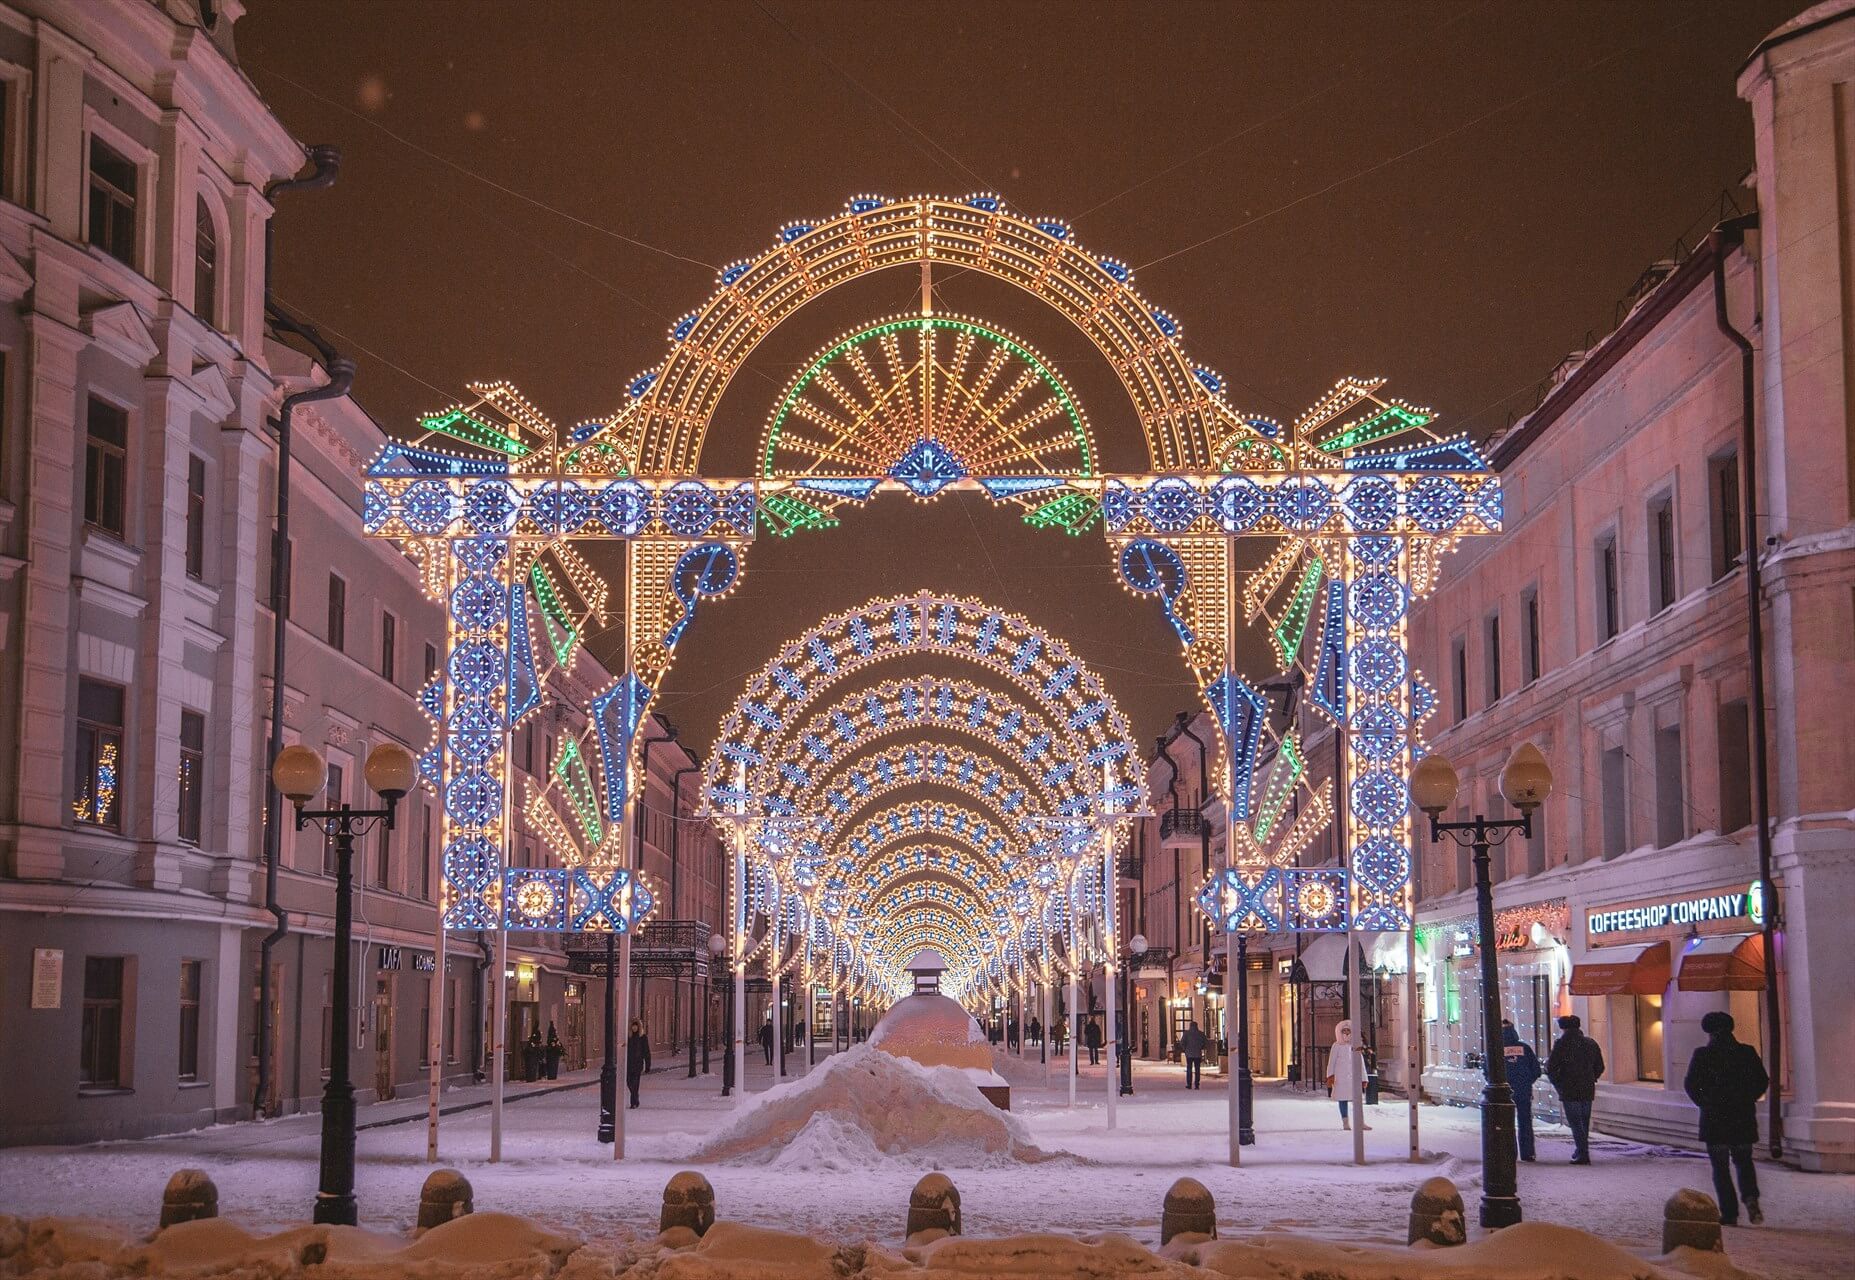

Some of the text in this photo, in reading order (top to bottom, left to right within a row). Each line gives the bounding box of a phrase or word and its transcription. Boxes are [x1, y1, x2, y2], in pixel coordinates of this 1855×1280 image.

[1588, 894, 1742, 933] COFFEESHOP COMPANY
[416, 954, 435, 971] LOUNG
